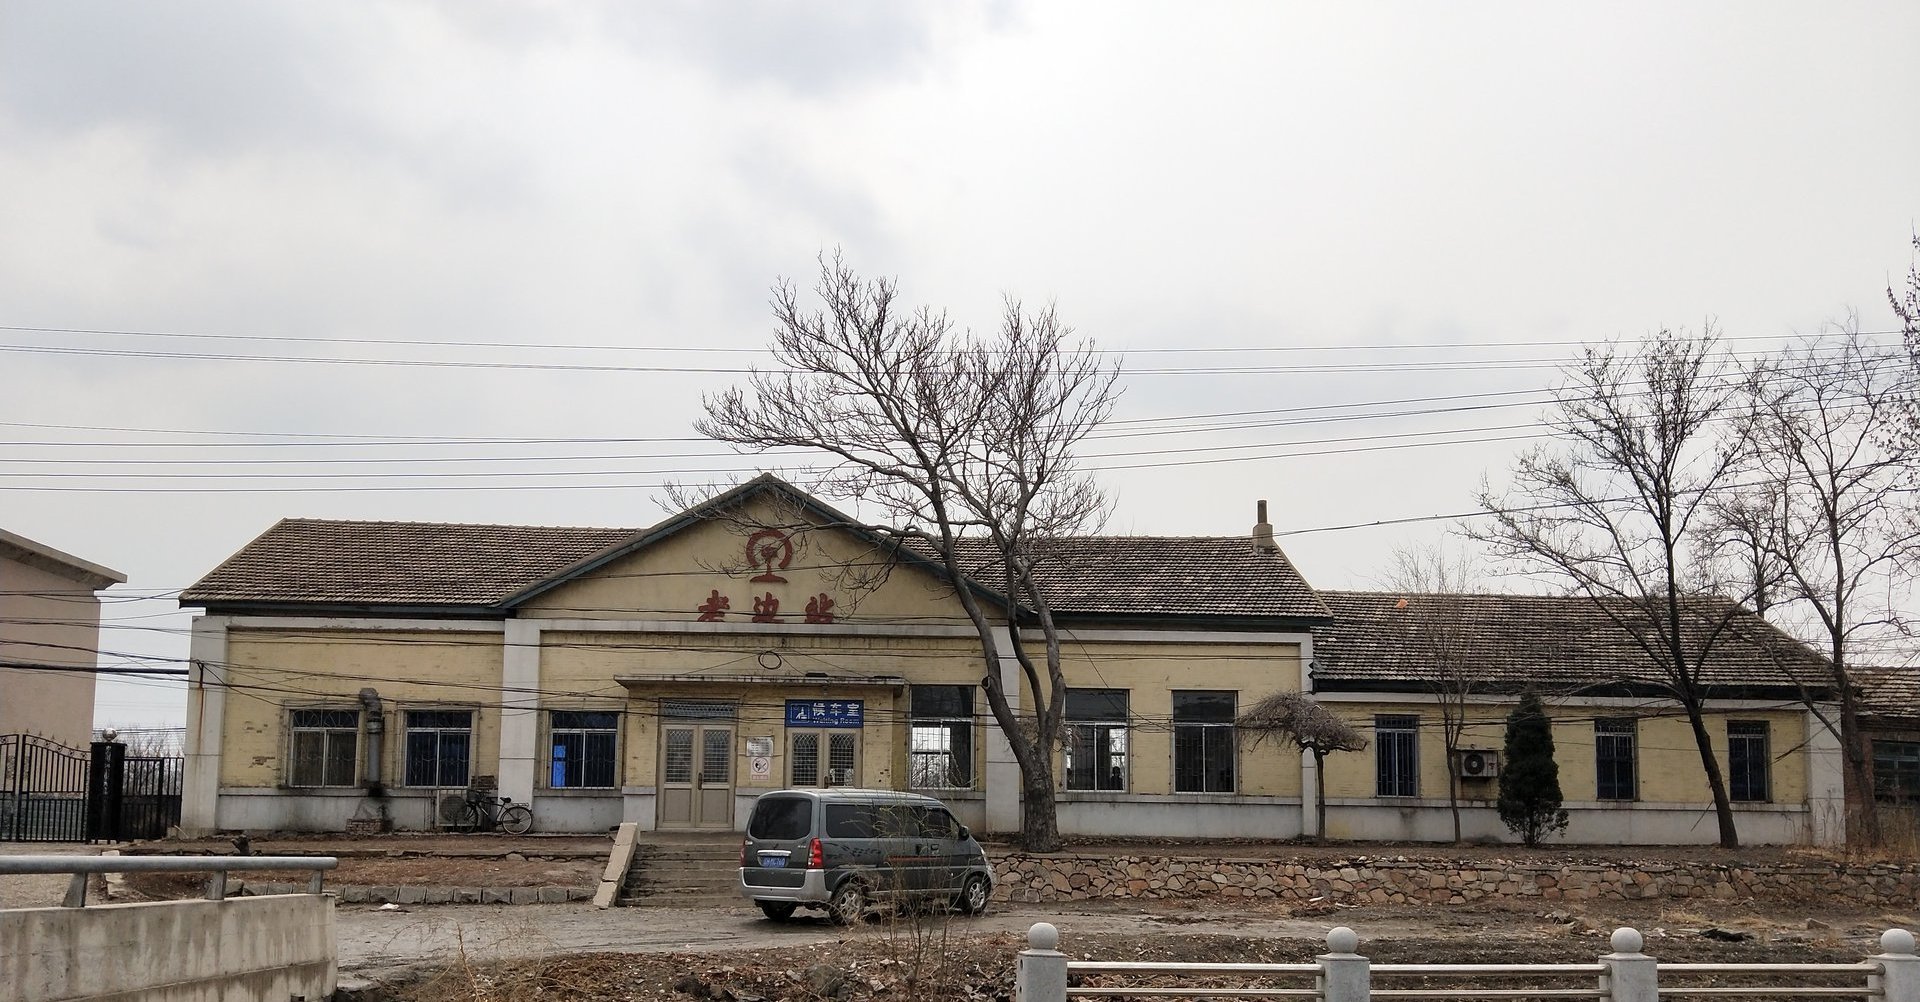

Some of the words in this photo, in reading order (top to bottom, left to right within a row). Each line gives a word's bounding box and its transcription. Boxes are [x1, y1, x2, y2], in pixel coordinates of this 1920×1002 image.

[697, 590, 834, 623] 老边站
[812, 703, 860, 717] 候车室
[812, 717, 839, 725] Waiting
